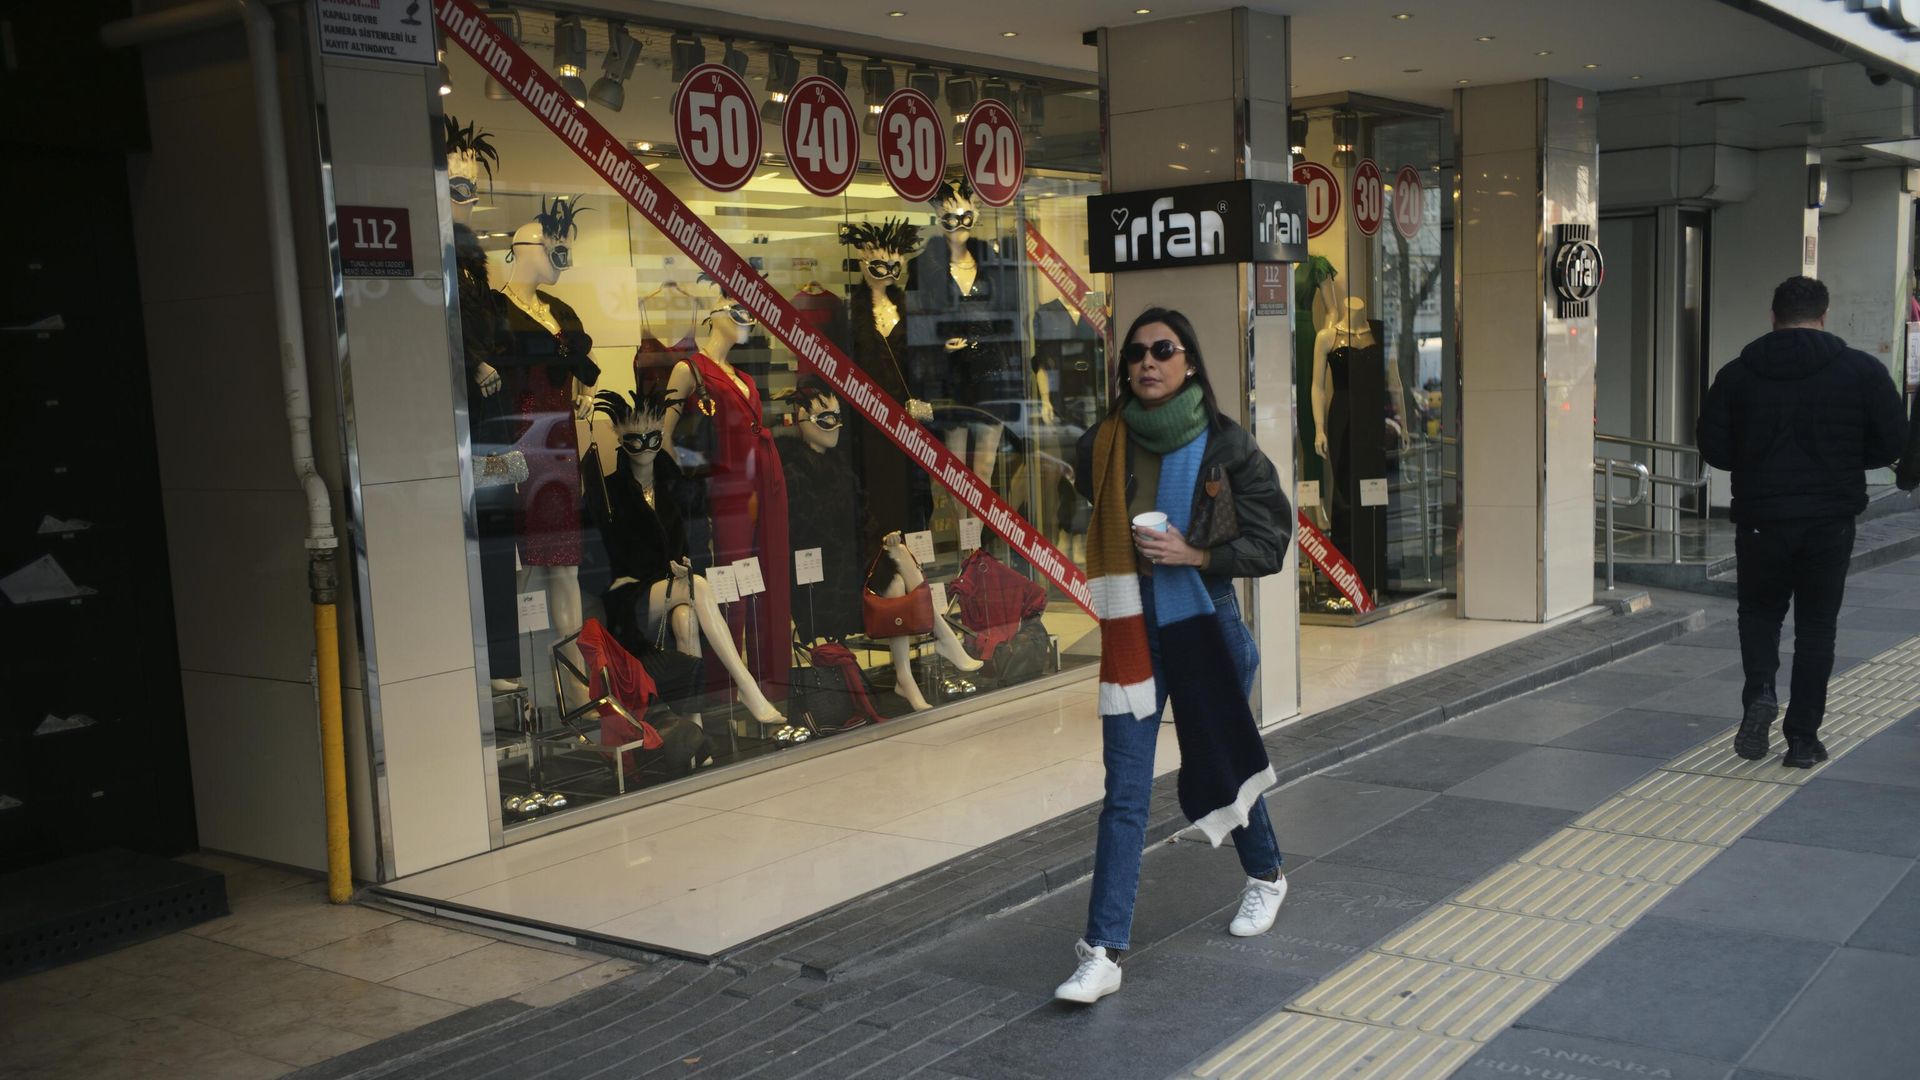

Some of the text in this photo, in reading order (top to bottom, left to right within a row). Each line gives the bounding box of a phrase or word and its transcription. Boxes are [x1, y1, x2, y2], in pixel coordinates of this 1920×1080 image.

[322, 9, 378, 25] KAPALI DEVRE
[323, 24, 357, 37] KAMERA
[359, 27, 403, 43] SİSTEMLERİ
[325, 39, 349, 50] KAYIT
[711, 75, 723, 93] %
[815, 86, 826, 104] %
[907, 98, 917, 115] %
[989, 108, 998, 124] %
[689, 91, 750, 169] 50
[796, 102, 849, 175] 40
[889, 113, 937, 182] 30
[975, 122, 1016, 188] 20
[1308, 177, 1329, 224] 0
[1356, 175, 1380, 222] 30
[1400, 180, 1420, 225] 20
[352, 217, 398, 249] 112
[1257, 200, 1302, 245] irfan
[1264, 265, 1280, 283] 112
[1530, 1046, 1673, 1079] ANKARA
